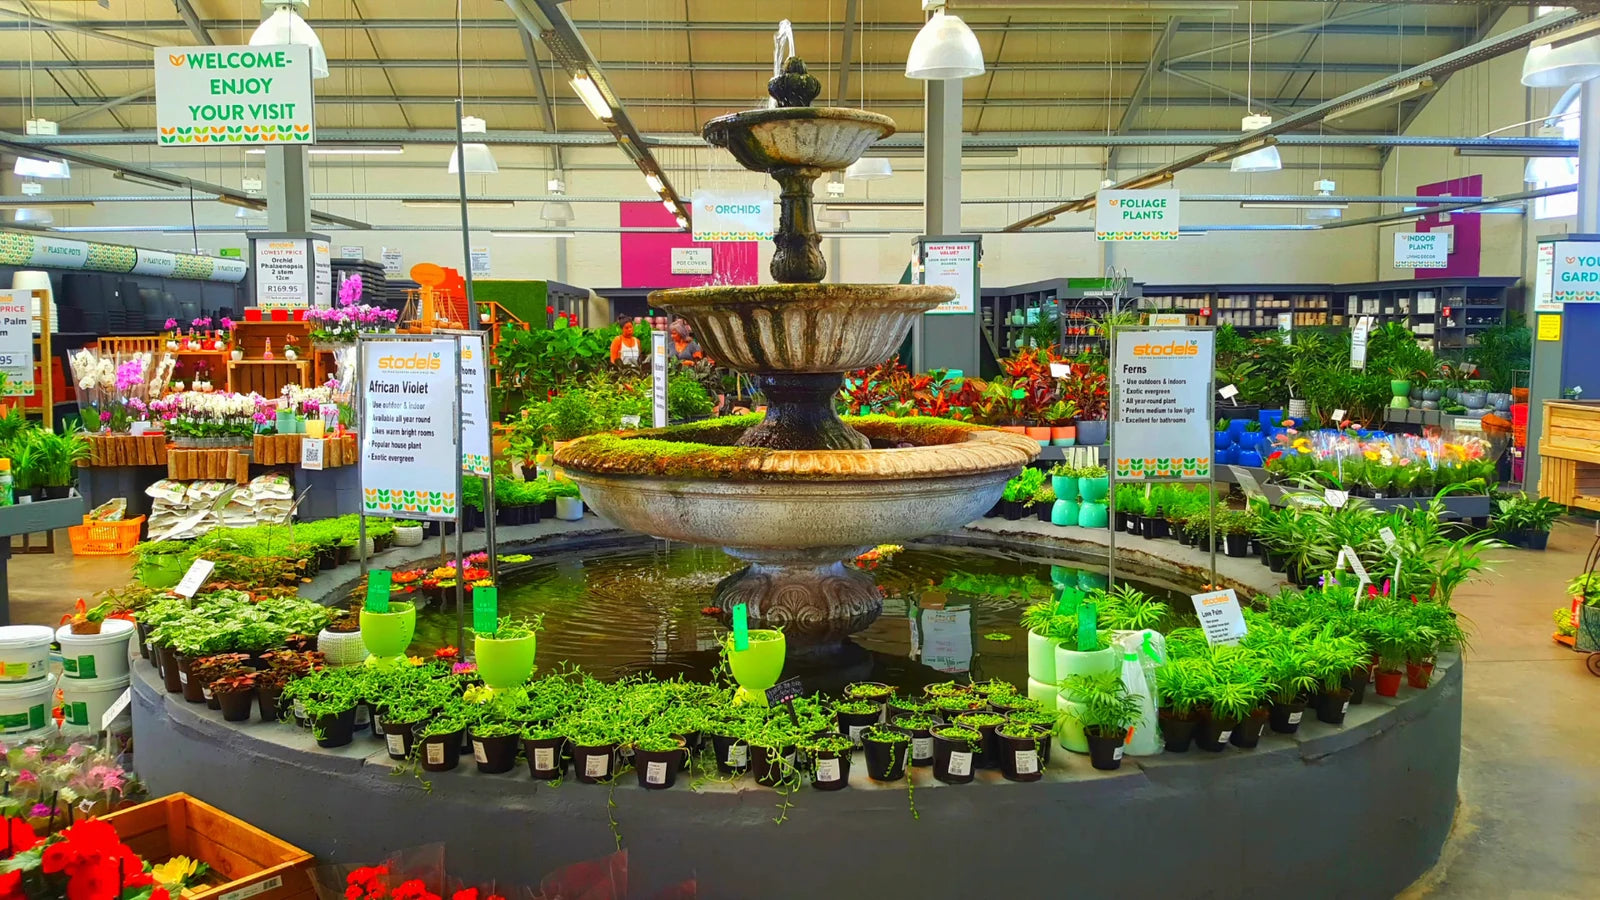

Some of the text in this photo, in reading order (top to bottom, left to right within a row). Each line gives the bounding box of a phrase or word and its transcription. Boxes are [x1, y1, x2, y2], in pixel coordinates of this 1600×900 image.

[186, 51, 292, 70] WELCOME-
[210, 78, 273, 95] ENJOY
[188, 103, 296, 121] YOUR VISIT
[1120, 199, 1167, 208] FOLIAGE
[715, 204, 761, 214] ORCHIDS
[1123, 211, 1164, 219] PLANTS
[47, 246, 81, 256] PLASTIC POTS
[147, 257, 162, 265] PLASTIC
[4, 317, 27, 325] Palm
[1132, 340, 1199, 356] stodels
[378, 352, 441, 370] stodels
[1123, 364, 1147, 373] Ferns
[369, 380, 429, 394] African Violet
[1144, 388, 1170, 396] evergreen
[372, 401, 382, 409] Use
[383, 401, 402, 409] outdoor
[408, 402, 426, 410] indoor
[372, 413, 431, 424] Available all year round
[401, 429, 417, 438] bright
[371, 440, 422, 450] Popular house plant
[371, 453, 415, 464] Exotic evergreen
[1201, 610, 1213, 618] Love
